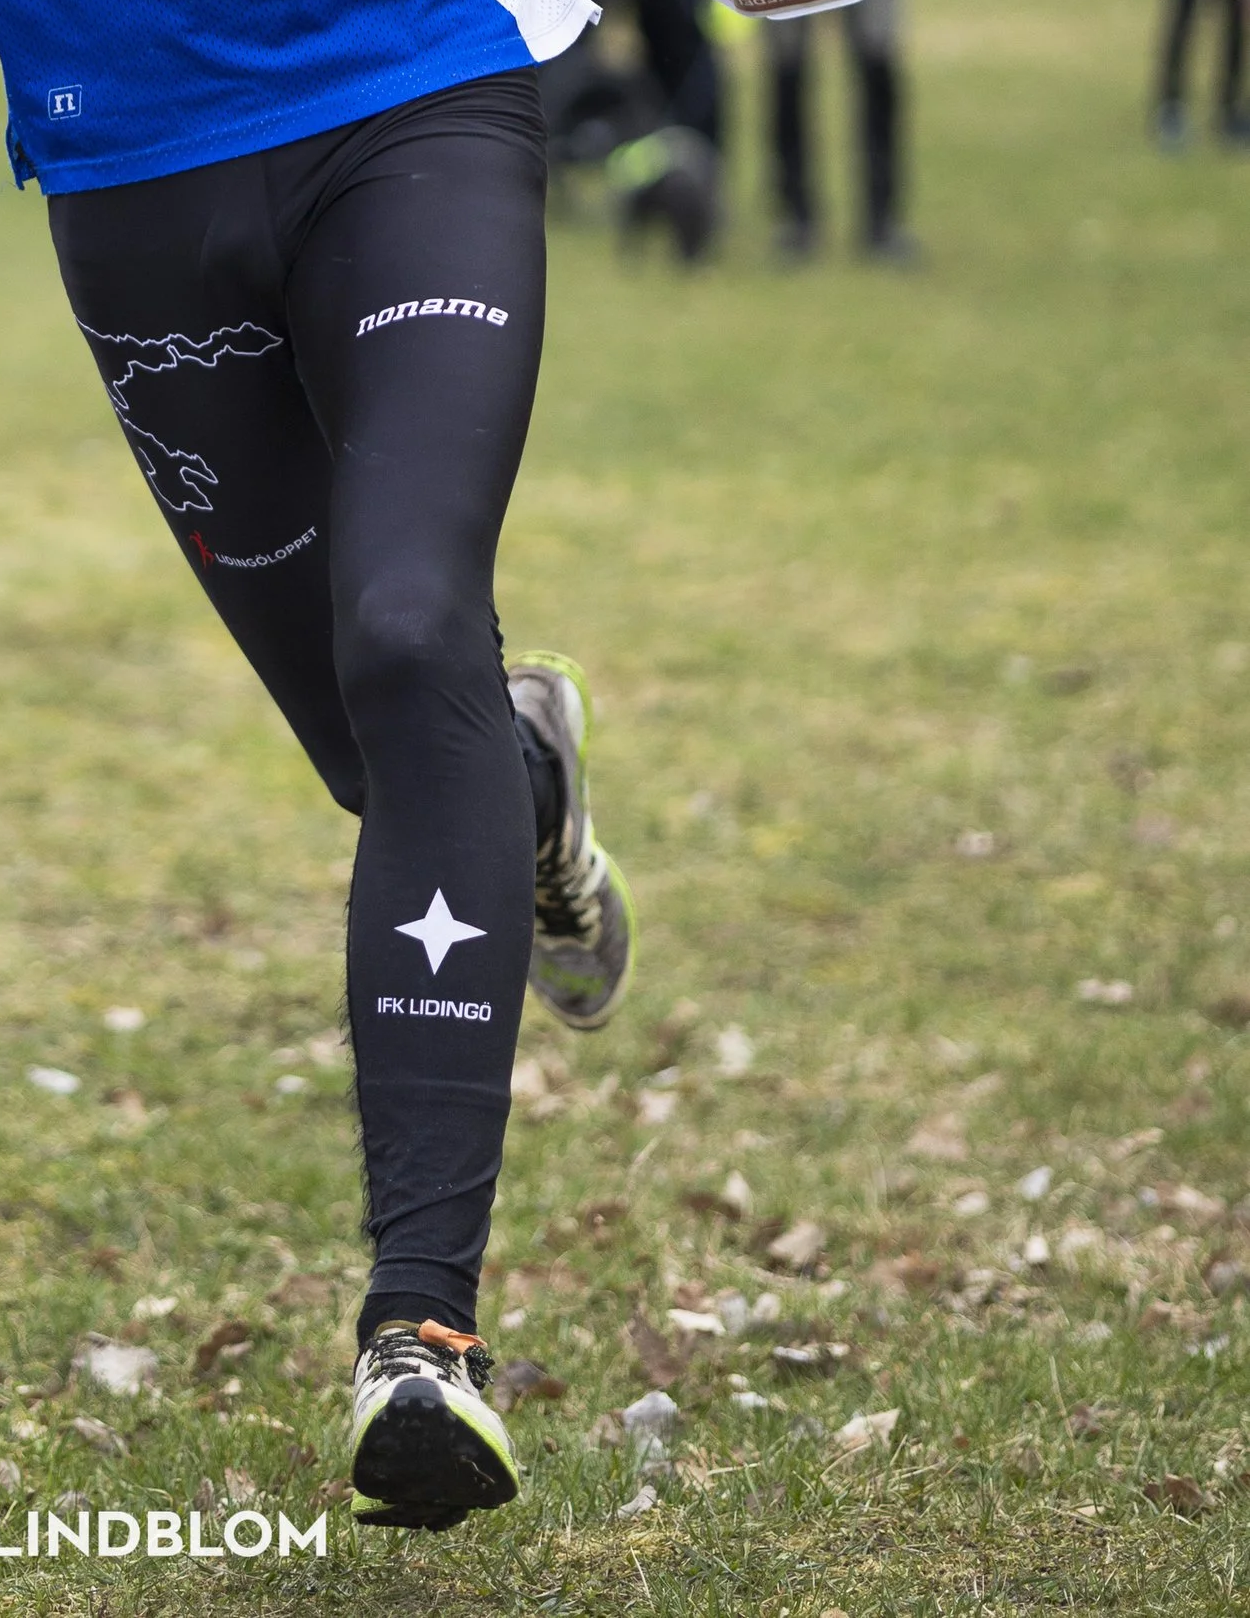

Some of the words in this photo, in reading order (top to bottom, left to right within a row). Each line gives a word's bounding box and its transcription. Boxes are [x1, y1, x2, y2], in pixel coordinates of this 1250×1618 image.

[356, 298, 509, 337] noname
[215, 526, 317, 568] LIDINGÖLOPPET
[377, 997, 405, 1014] IFK
[409, 998, 492, 1022] LIDINGÖ
